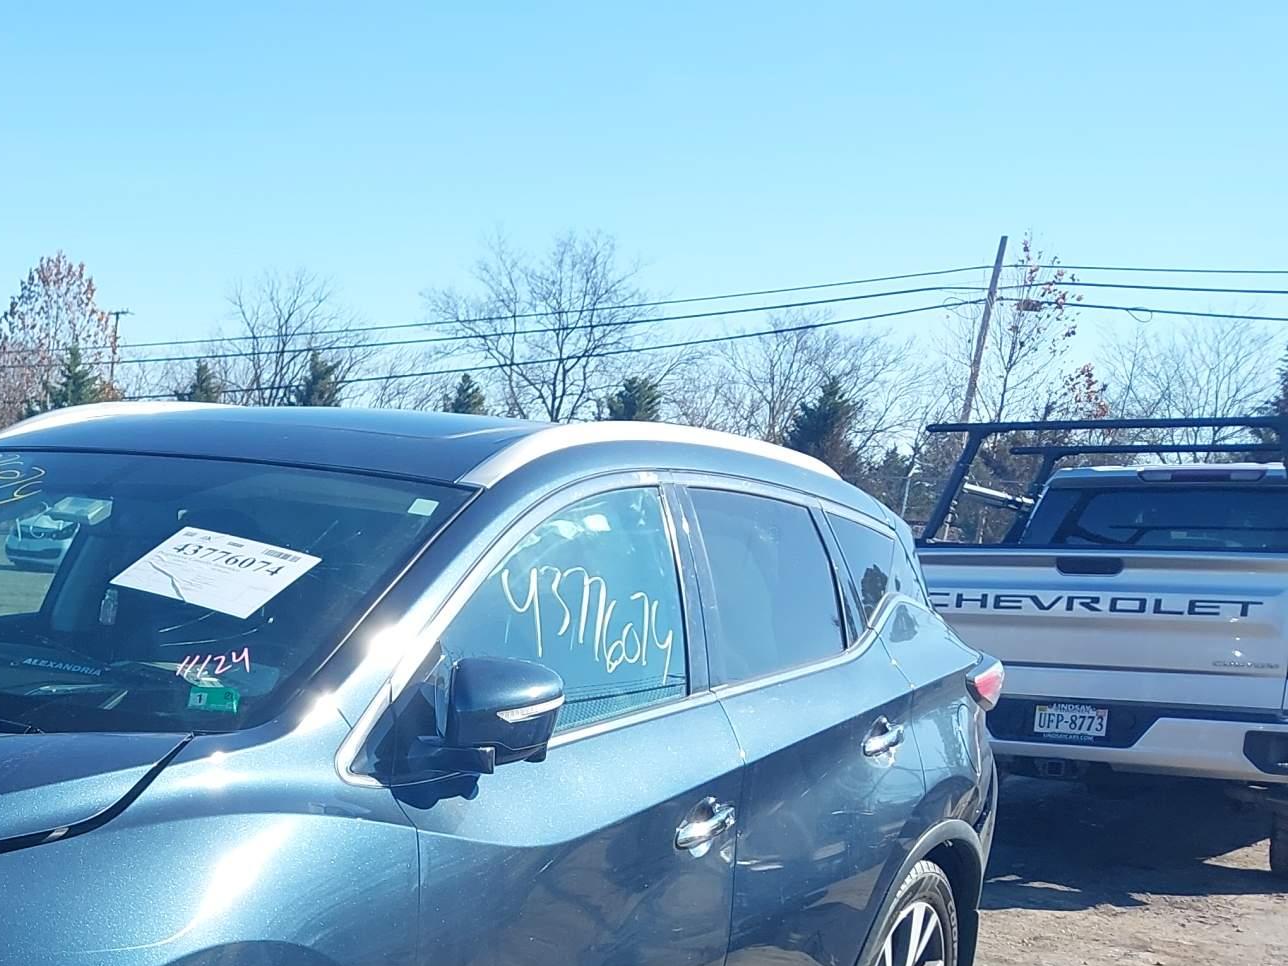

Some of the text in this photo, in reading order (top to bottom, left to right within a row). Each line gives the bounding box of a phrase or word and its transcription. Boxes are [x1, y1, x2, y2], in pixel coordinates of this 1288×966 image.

[173, 543, 285, 576] 43776074
[501, 565, 673, 685] 43776074
[23, 658, 101, 676] ALEXANDRIA
[1038, 712, 1104, 732] UFP-8773
